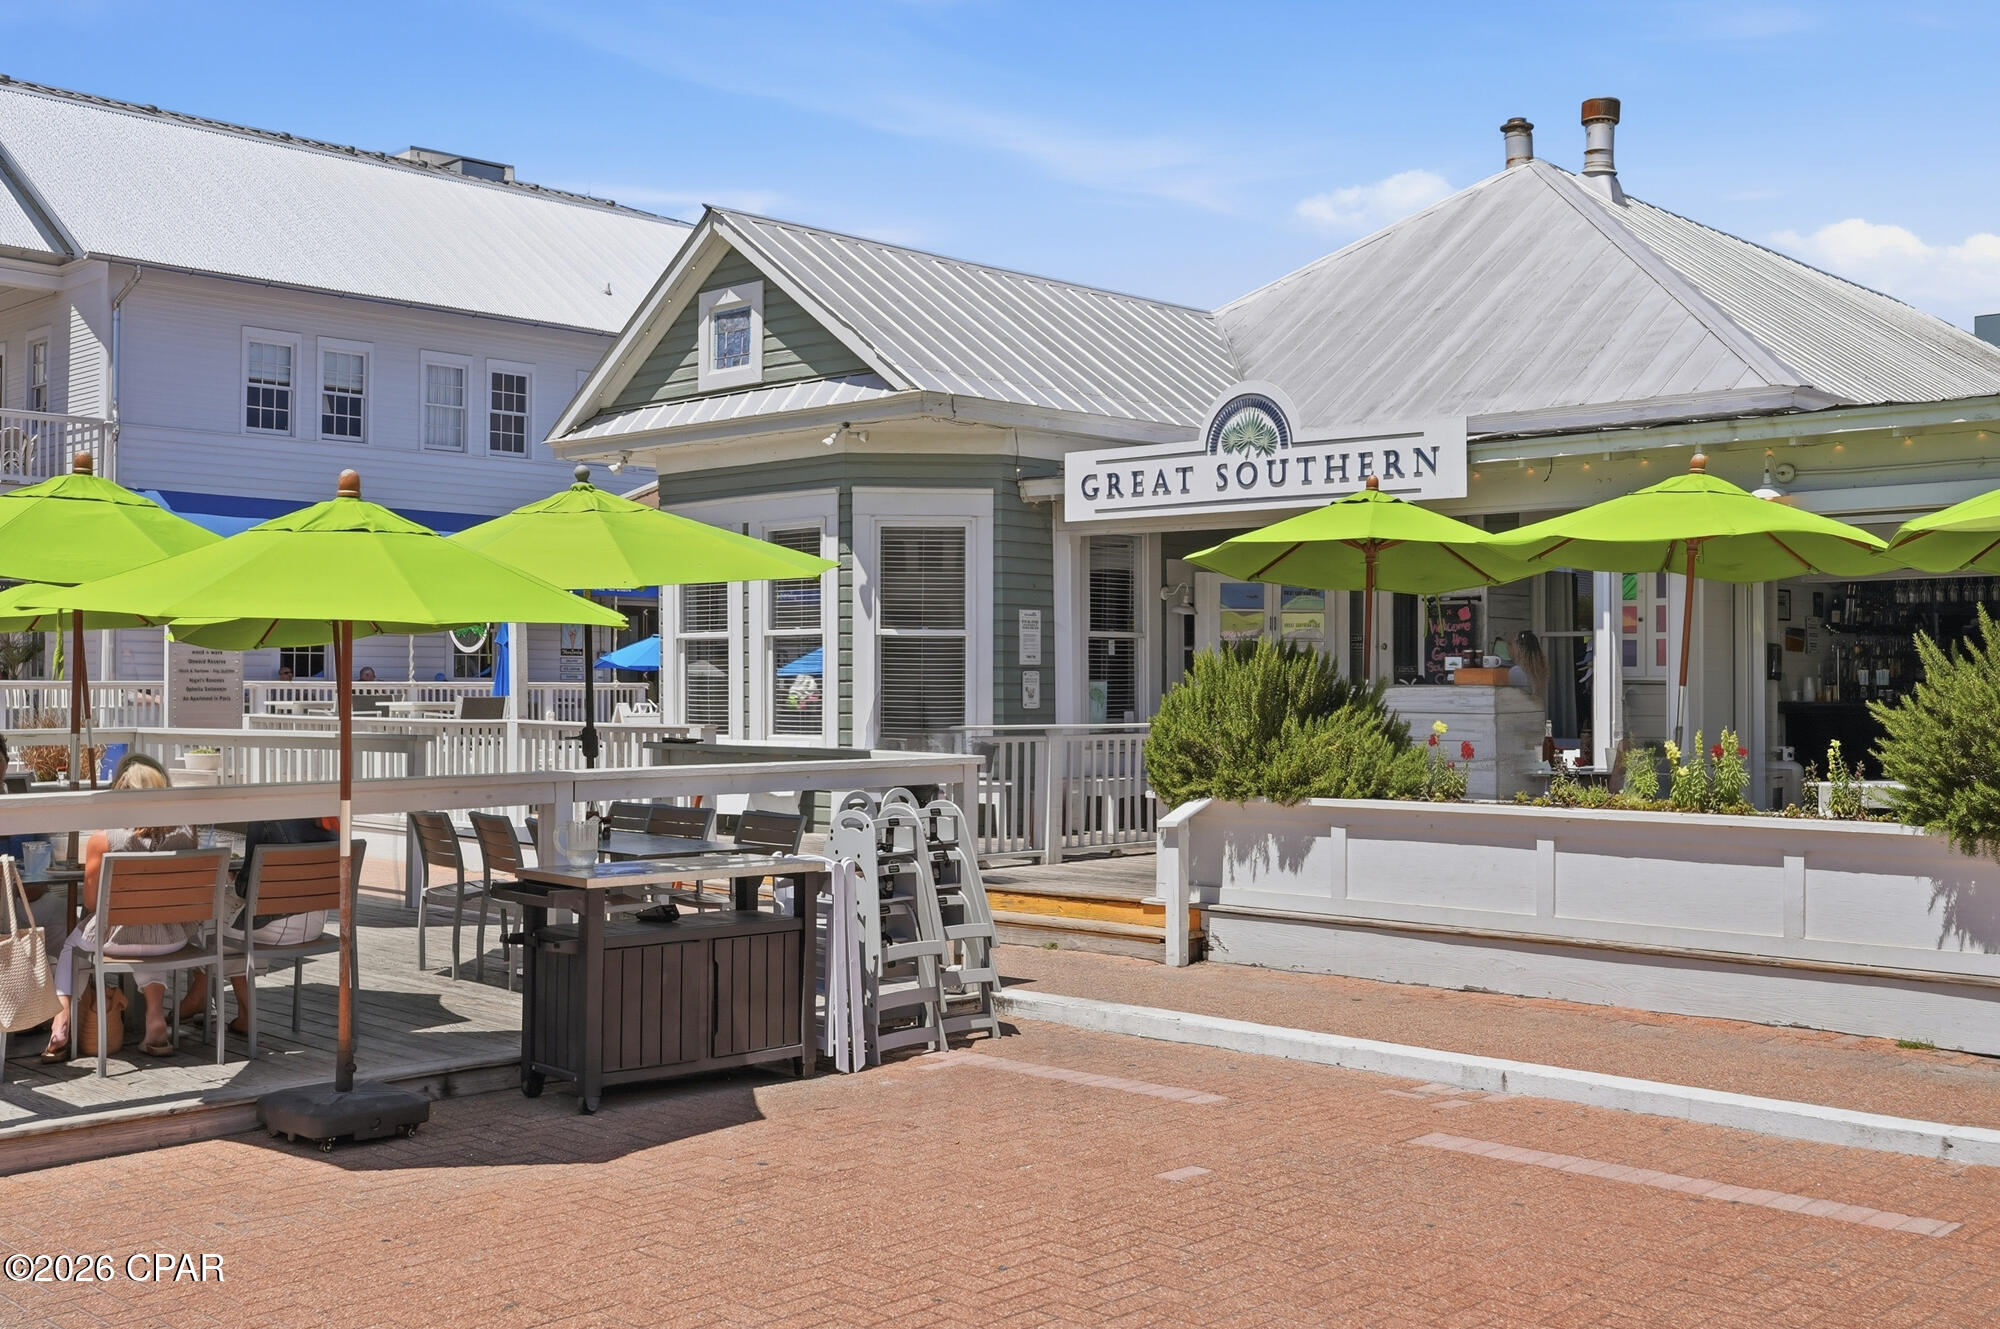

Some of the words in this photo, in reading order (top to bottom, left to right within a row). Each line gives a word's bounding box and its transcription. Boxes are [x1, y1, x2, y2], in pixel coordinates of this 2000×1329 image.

[1081, 466, 1194, 501] GREAT
[1215, 446, 1440, 492] SOUTHERN
[1434, 633, 1447, 647] to
